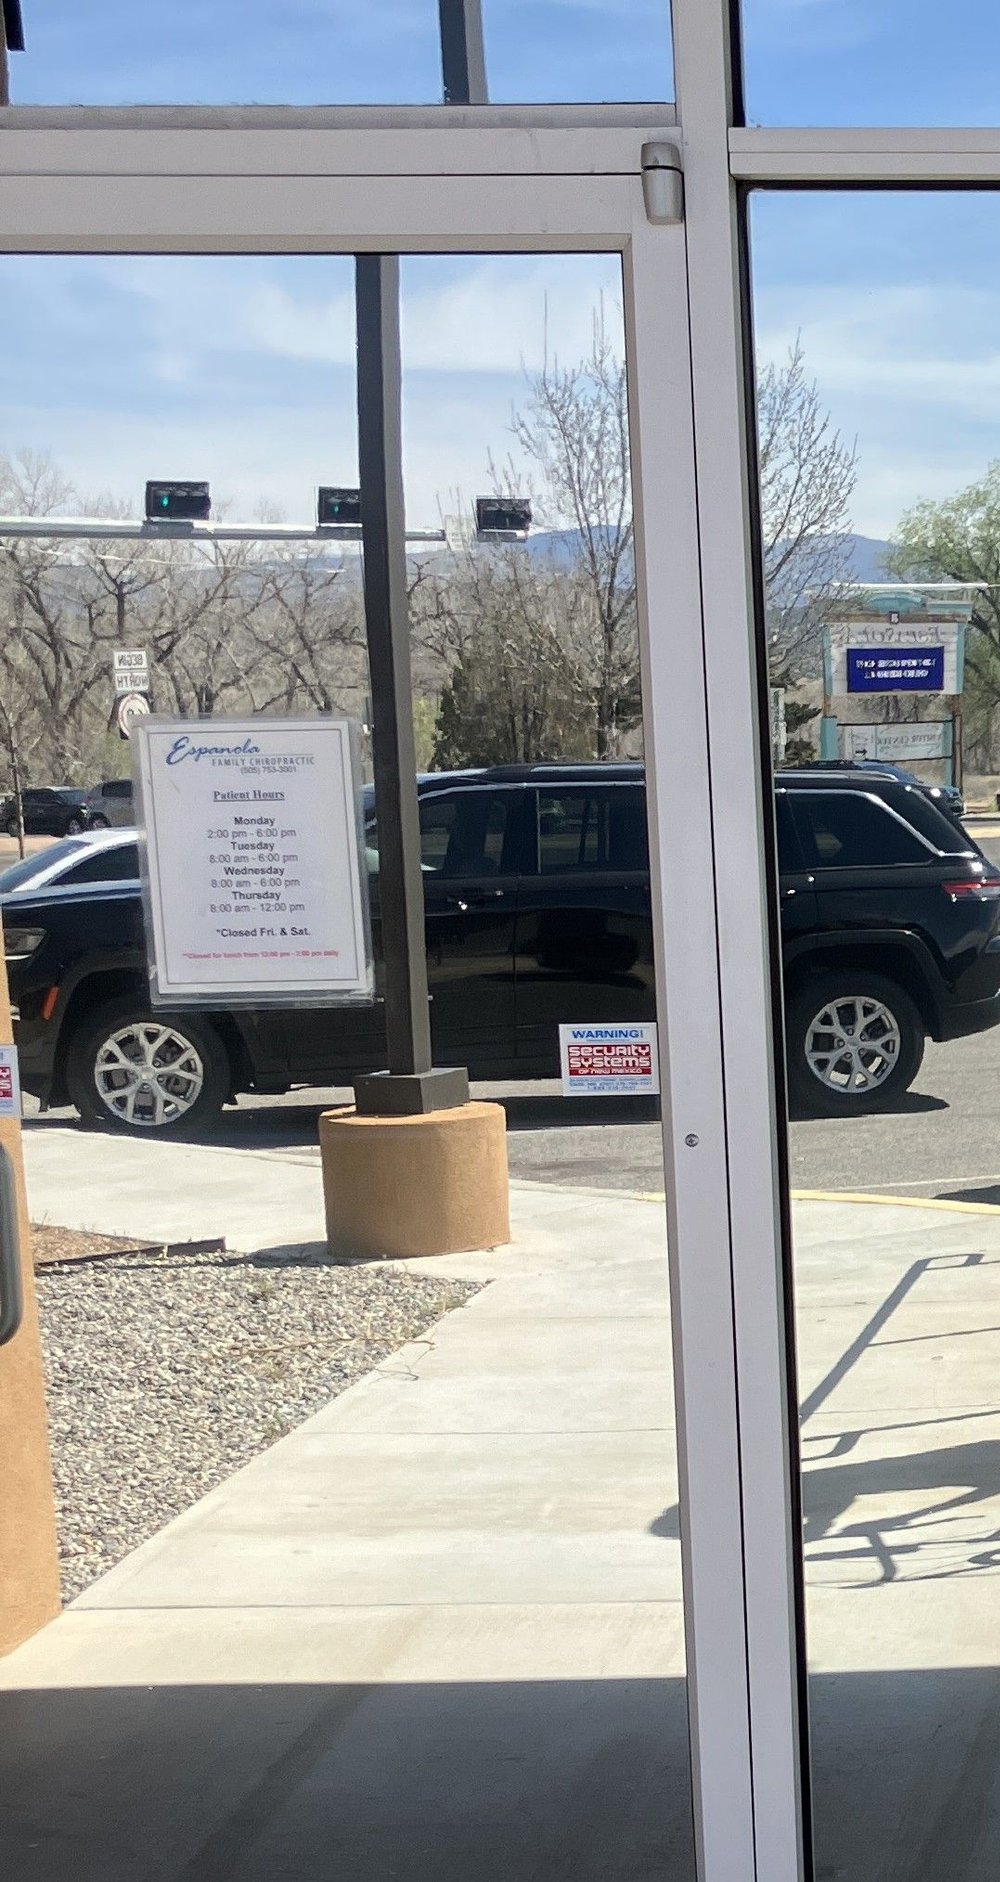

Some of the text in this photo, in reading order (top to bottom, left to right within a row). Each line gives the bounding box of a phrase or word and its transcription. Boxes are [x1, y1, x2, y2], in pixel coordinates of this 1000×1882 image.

[165, 736, 261, 765] Espanola
[212, 756, 315, 767] FAMILY CHIROPRACTIC
[240, 766, 261, 775] (505)
[213, 789, 285, 800] Patient Hours
[233, 816, 276, 827] Monday
[207, 830, 229, 839] 2:00
[231, 831, 247, 840] pm
[256, 829, 278, 838] 6:00
[280, 830, 297, 839] pm
[230, 841, 275, 851] Tuesday
[209, 854, 231, 863] 8:00
[233, 855, 249, 863] am
[258, 854, 280, 862] 6:00
[282, 854, 299, 864] pm
[224, 867, 286, 876] Wednesday
[211, 879, 233, 888] 8:00
[235, 880, 251, 888] am
[260, 878, 282, 887] 6:00
[284, 879, 301, 889] pm
[231, 891, 281, 901] Thursday
[210, 904, 232, 913] 8:00
[234, 905, 250, 913] am
[260, 903, 287, 912] 12:00
[289, 904, 305, 913] pm
[260, 928, 276, 937] Fri.
[280, 928, 288, 936] &
[291, 927, 311, 936] Sat.
[571, 1029, 645, 1039] WARNING!
